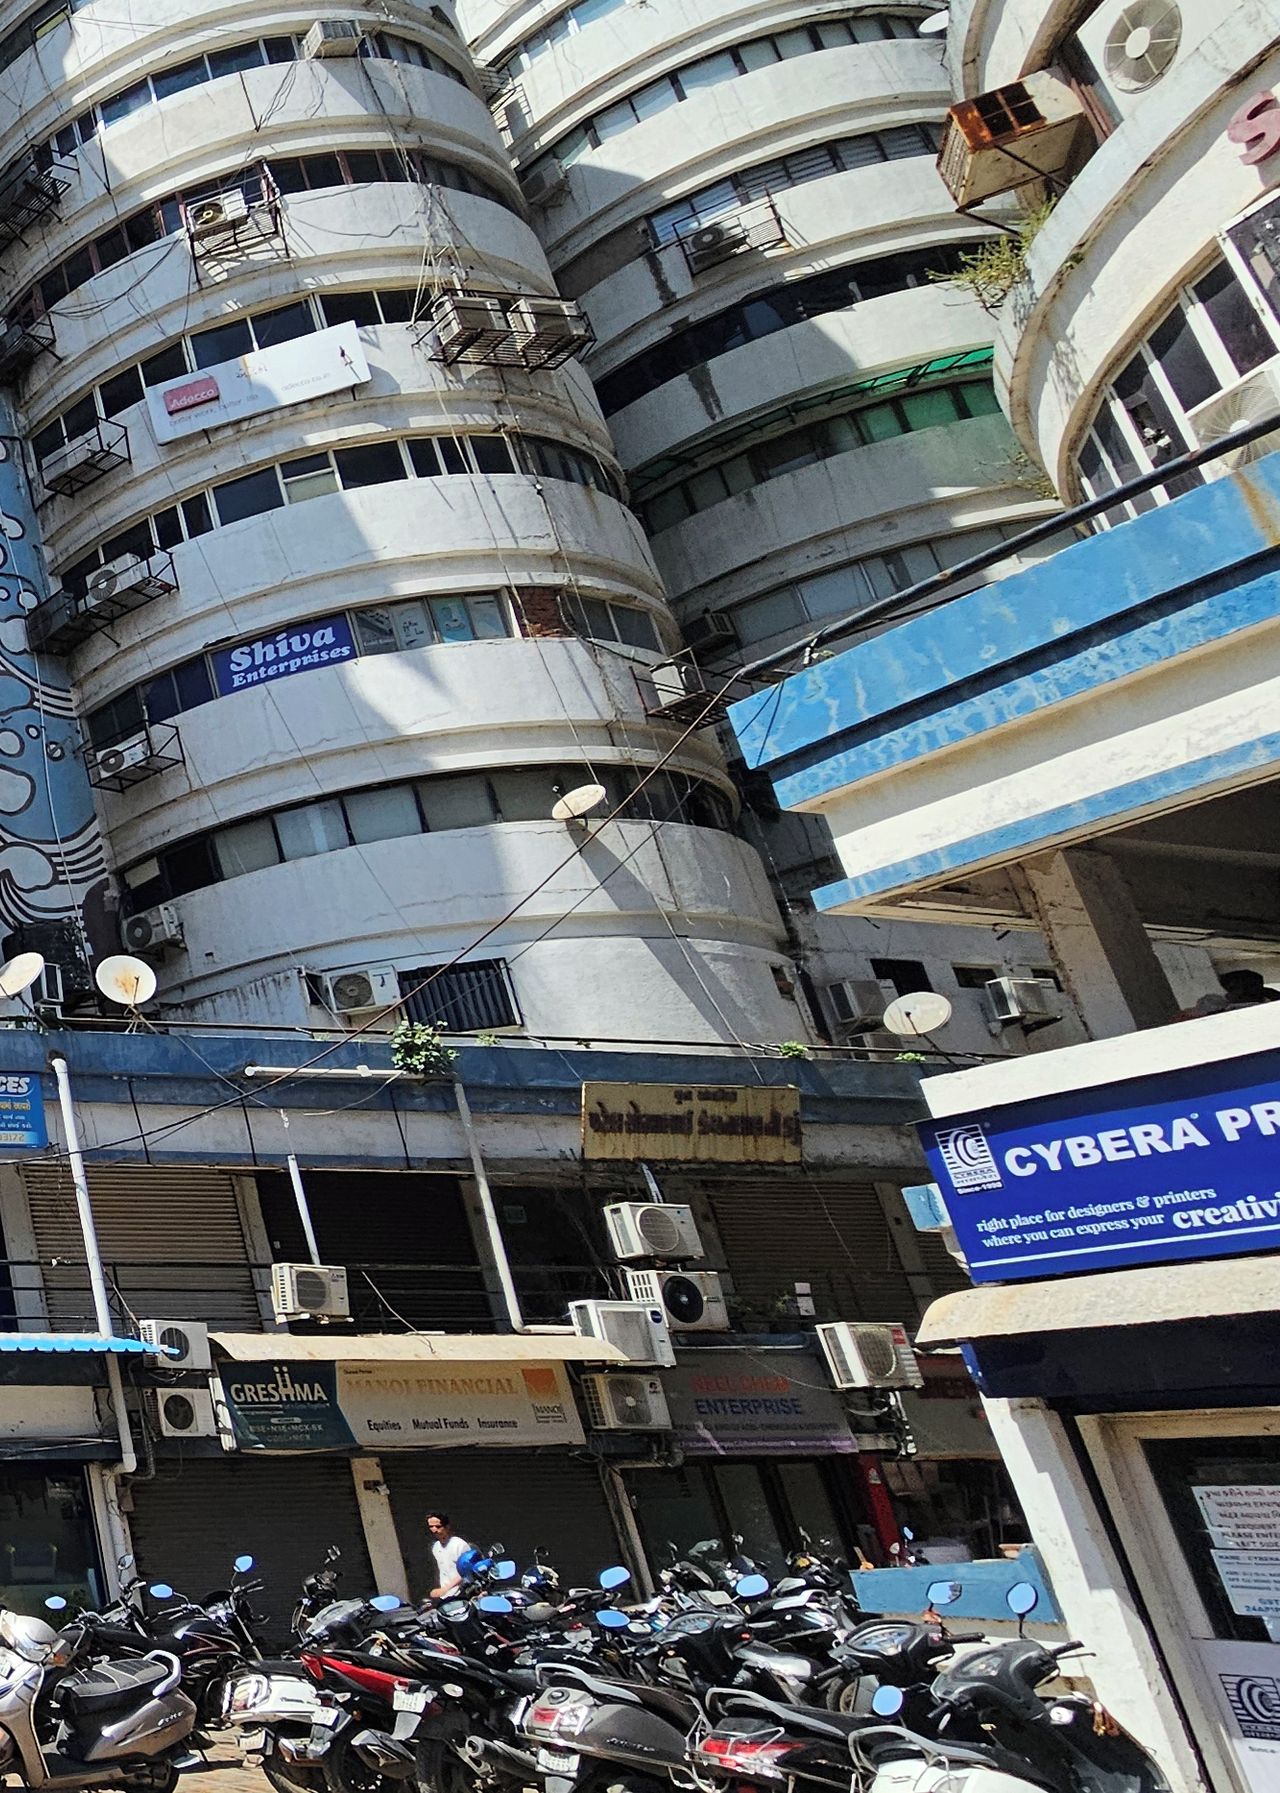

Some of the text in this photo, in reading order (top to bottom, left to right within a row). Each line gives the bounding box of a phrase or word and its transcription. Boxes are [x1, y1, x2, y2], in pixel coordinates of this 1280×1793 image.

[170, 388, 215, 409] Adecco
[230, 626, 336, 672] Shiva
[232, 646, 351, 688] Enterprises
[1004, 1116, 1210, 1177] CYBERA
[976, 1187, 1217, 1233] right place for designers & printers
[982, 1231, 1022, 1248] where
[1024, 1229, 1049, 1245] you
[1050, 1226, 1075, 1239] can
[1076, 1219, 1130, 1236] express
[1130, 1213, 1165, 1230] your
[230, 1366, 328, 1402] GRESHMA
[344, 1376, 519, 1395] MANOJ FINANCIAL
[694, 1398, 802, 1415] ENTERPRISE
[367, 1417, 518, 1432] Equities Mutual Funds Insurance
